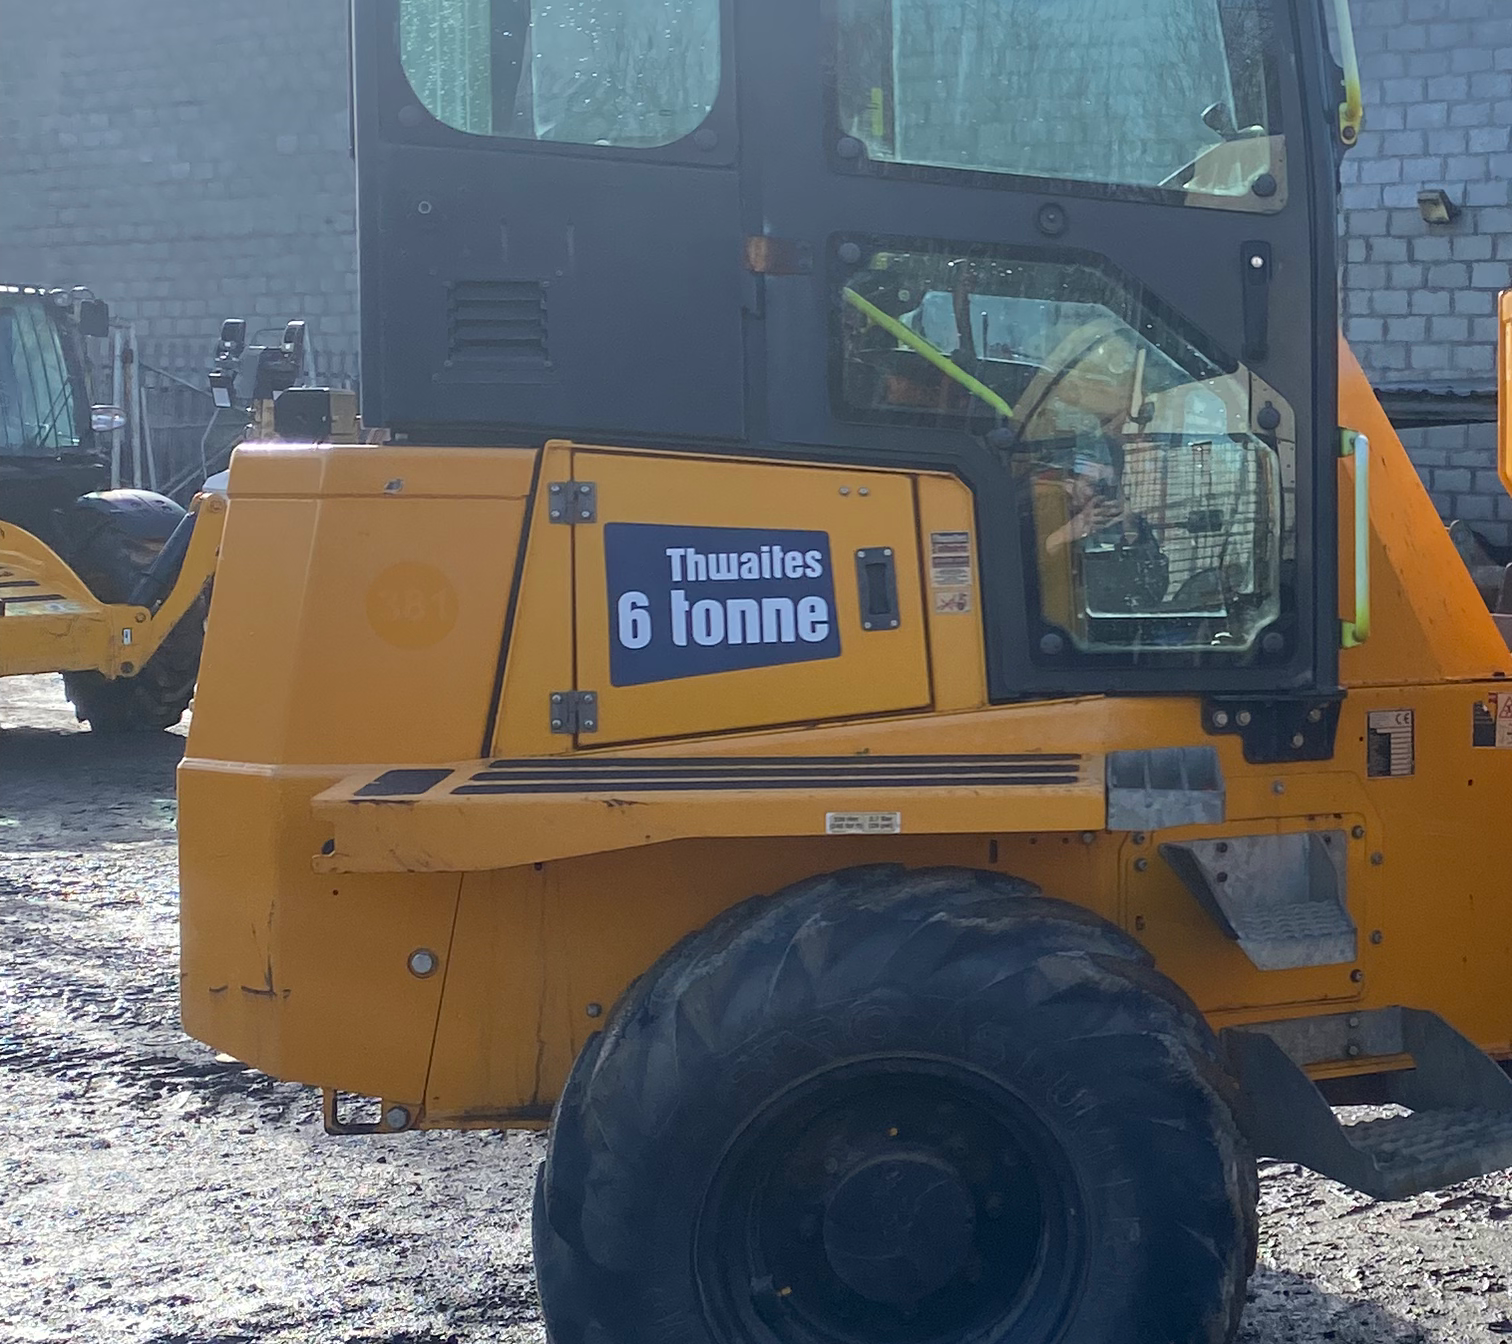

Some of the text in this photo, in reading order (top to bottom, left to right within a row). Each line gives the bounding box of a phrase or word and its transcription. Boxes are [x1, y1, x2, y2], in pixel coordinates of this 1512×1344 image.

[665, 545, 823, 583] Thwaites
[617, 589, 830, 650] 6 tonne
[1395, 712, 1410, 725] CE
